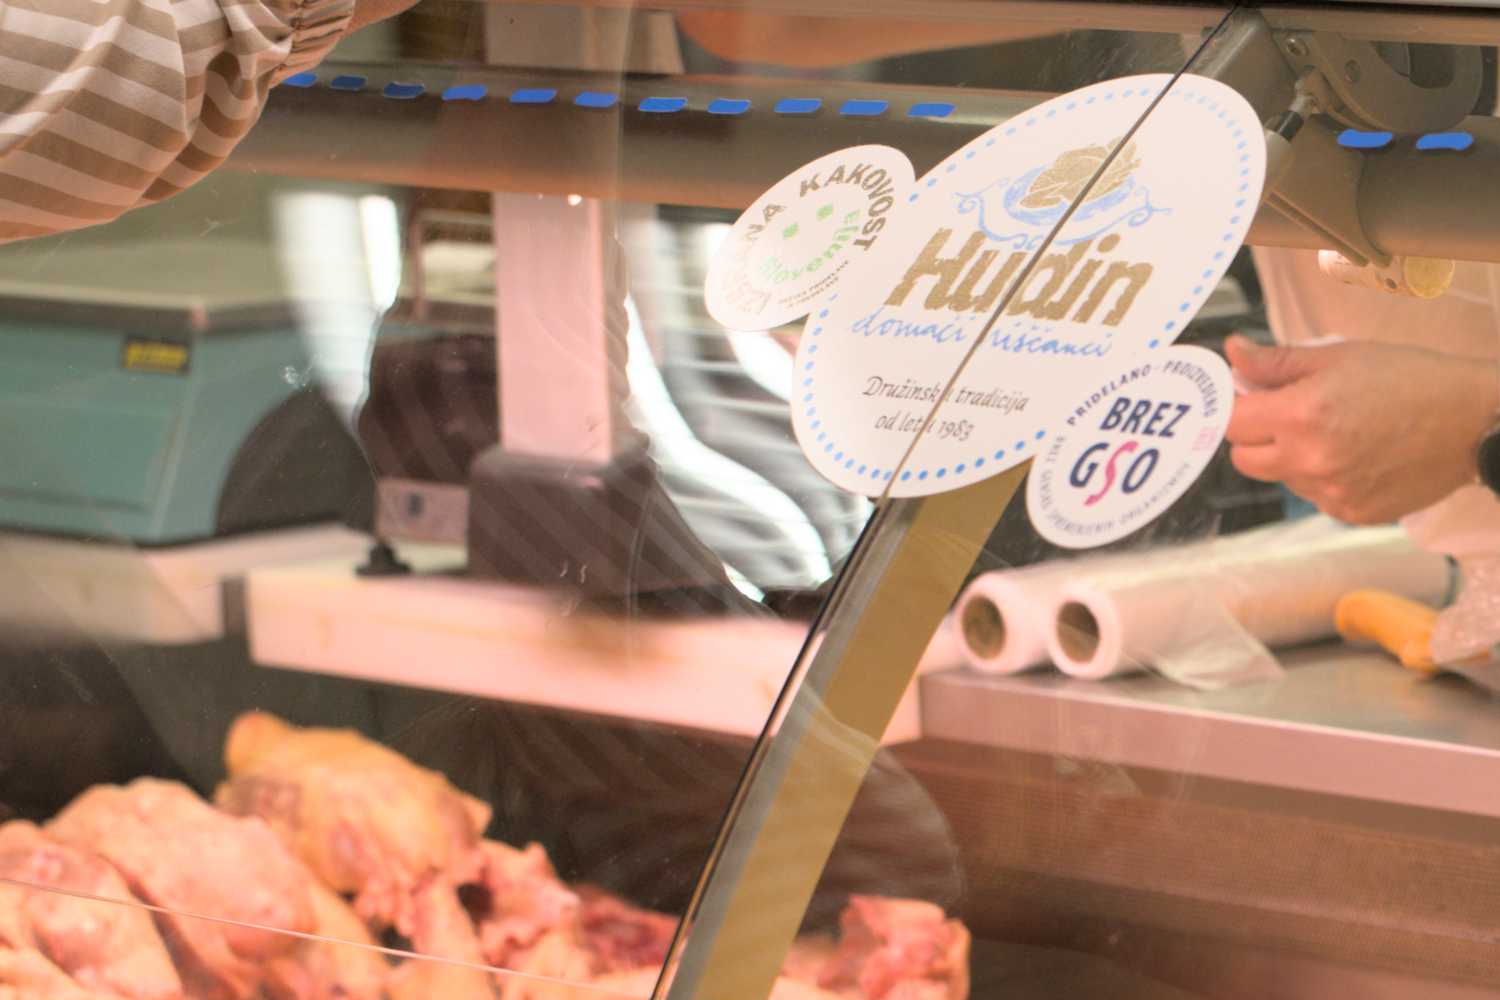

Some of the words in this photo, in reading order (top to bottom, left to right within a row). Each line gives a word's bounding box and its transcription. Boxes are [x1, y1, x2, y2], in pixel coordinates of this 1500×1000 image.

[799, 162, 895, 252] KAKOVOST
[884, 228, 1154, 327] Hudin
[874, 409, 902, 431] od
[937, 418, 976, 442] 1983
[955, 386, 1030, 416] tradicija
[1066, 364, 1151, 427] PRIDELANO
[1099, 396, 1193, 438] BREZ
[1069, 440, 1160, 507] GSO
